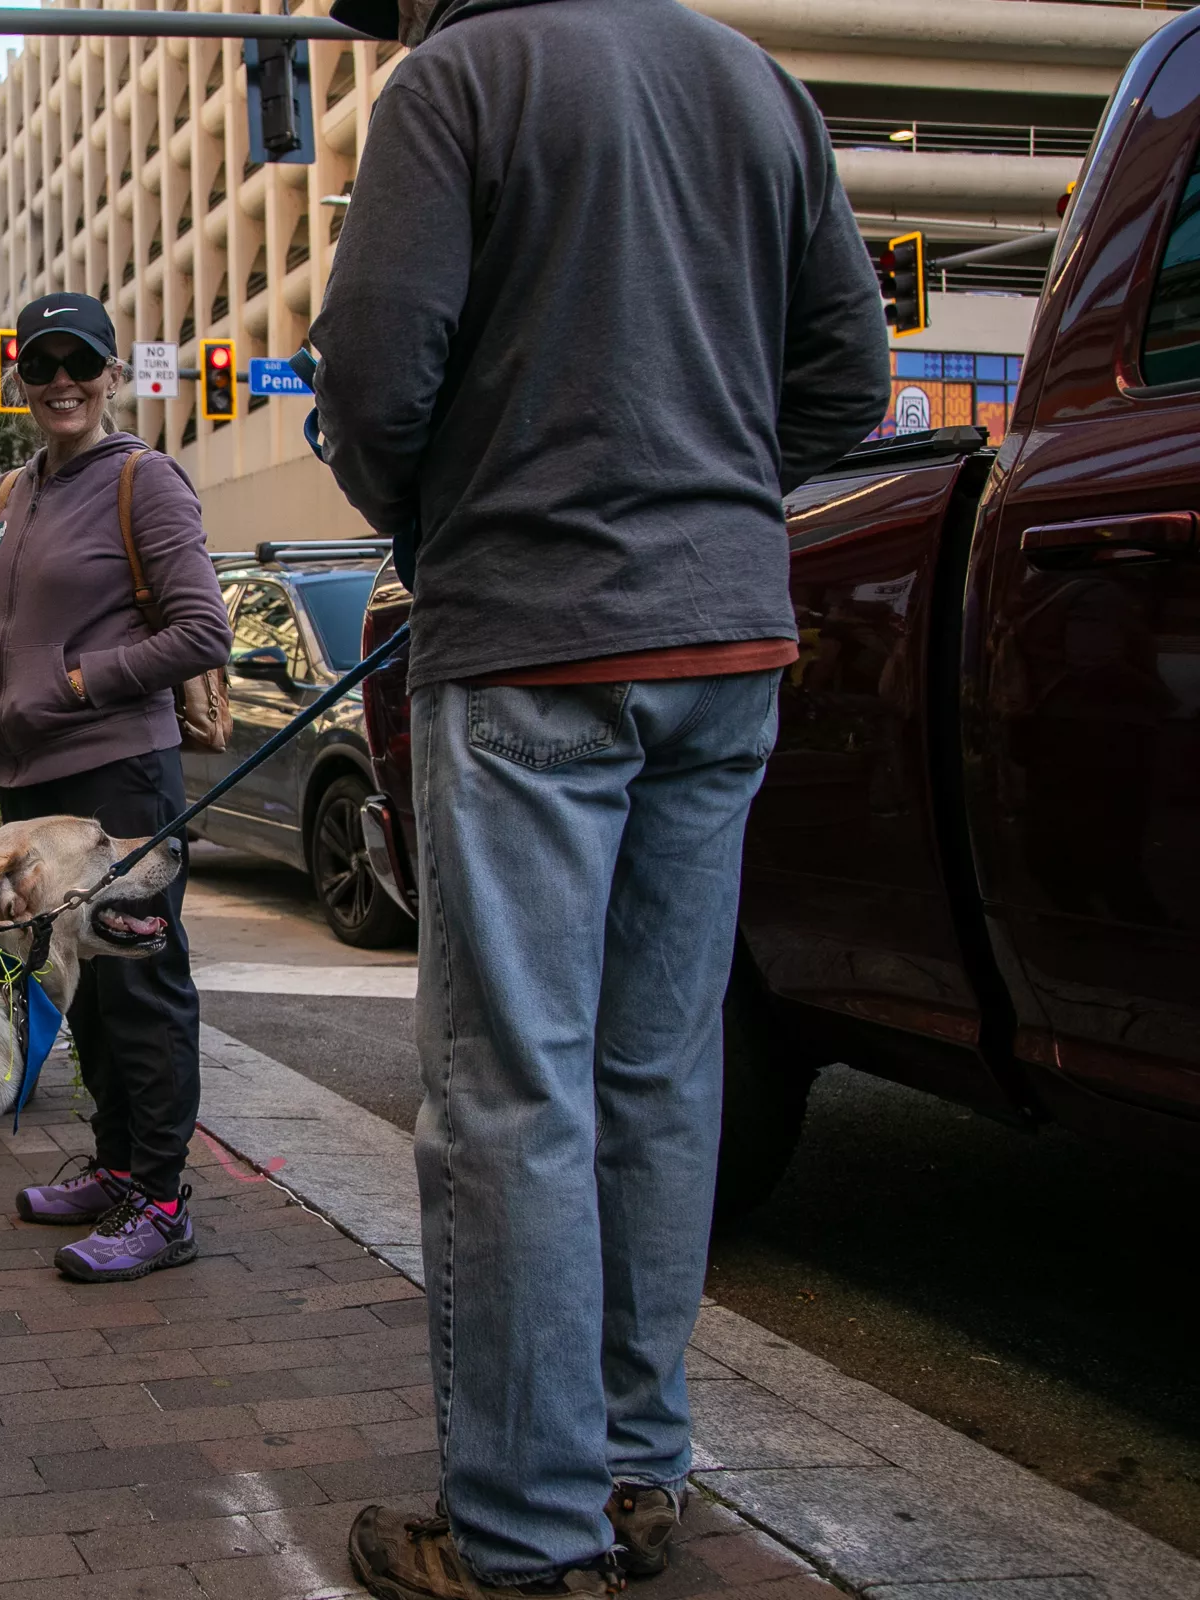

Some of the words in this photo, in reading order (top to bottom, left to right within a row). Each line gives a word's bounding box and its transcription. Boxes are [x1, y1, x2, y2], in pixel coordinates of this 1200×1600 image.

[146, 346, 165, 358] NO
[143, 359, 170, 368] TURN
[138, 370, 153, 380] ON
[155, 370, 175, 380] RED
[261, 373, 303, 390] Penn
